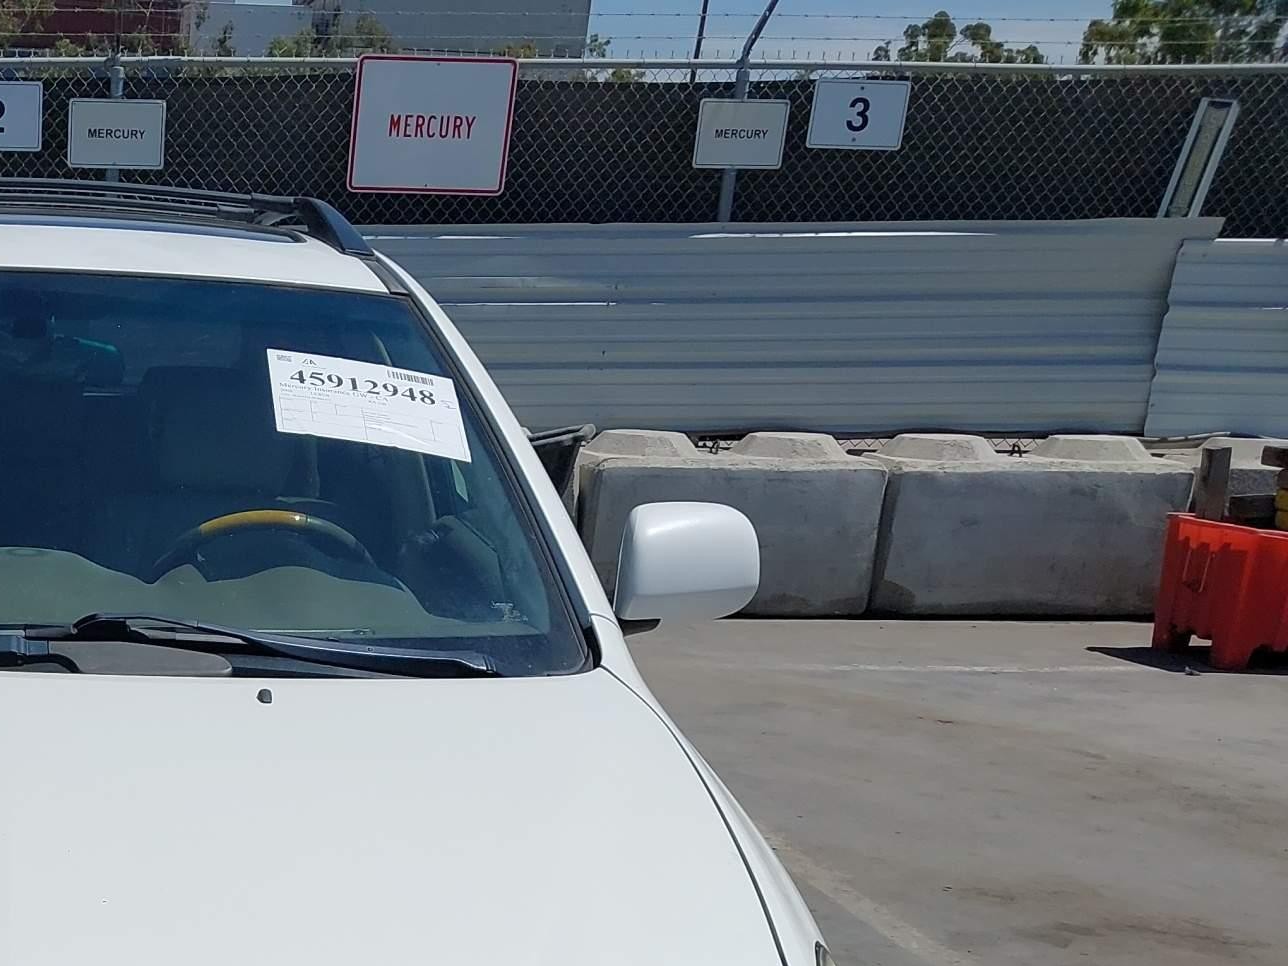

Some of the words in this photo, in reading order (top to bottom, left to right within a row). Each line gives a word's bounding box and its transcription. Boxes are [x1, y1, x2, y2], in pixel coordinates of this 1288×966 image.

[388, 113, 478, 141] MERCURY
[845, 96, 871, 132] 3
[87, 128, 146, 140] MERCURY
[714, 128, 769, 140] MERCURY
[289, 369, 437, 406] 45912948
